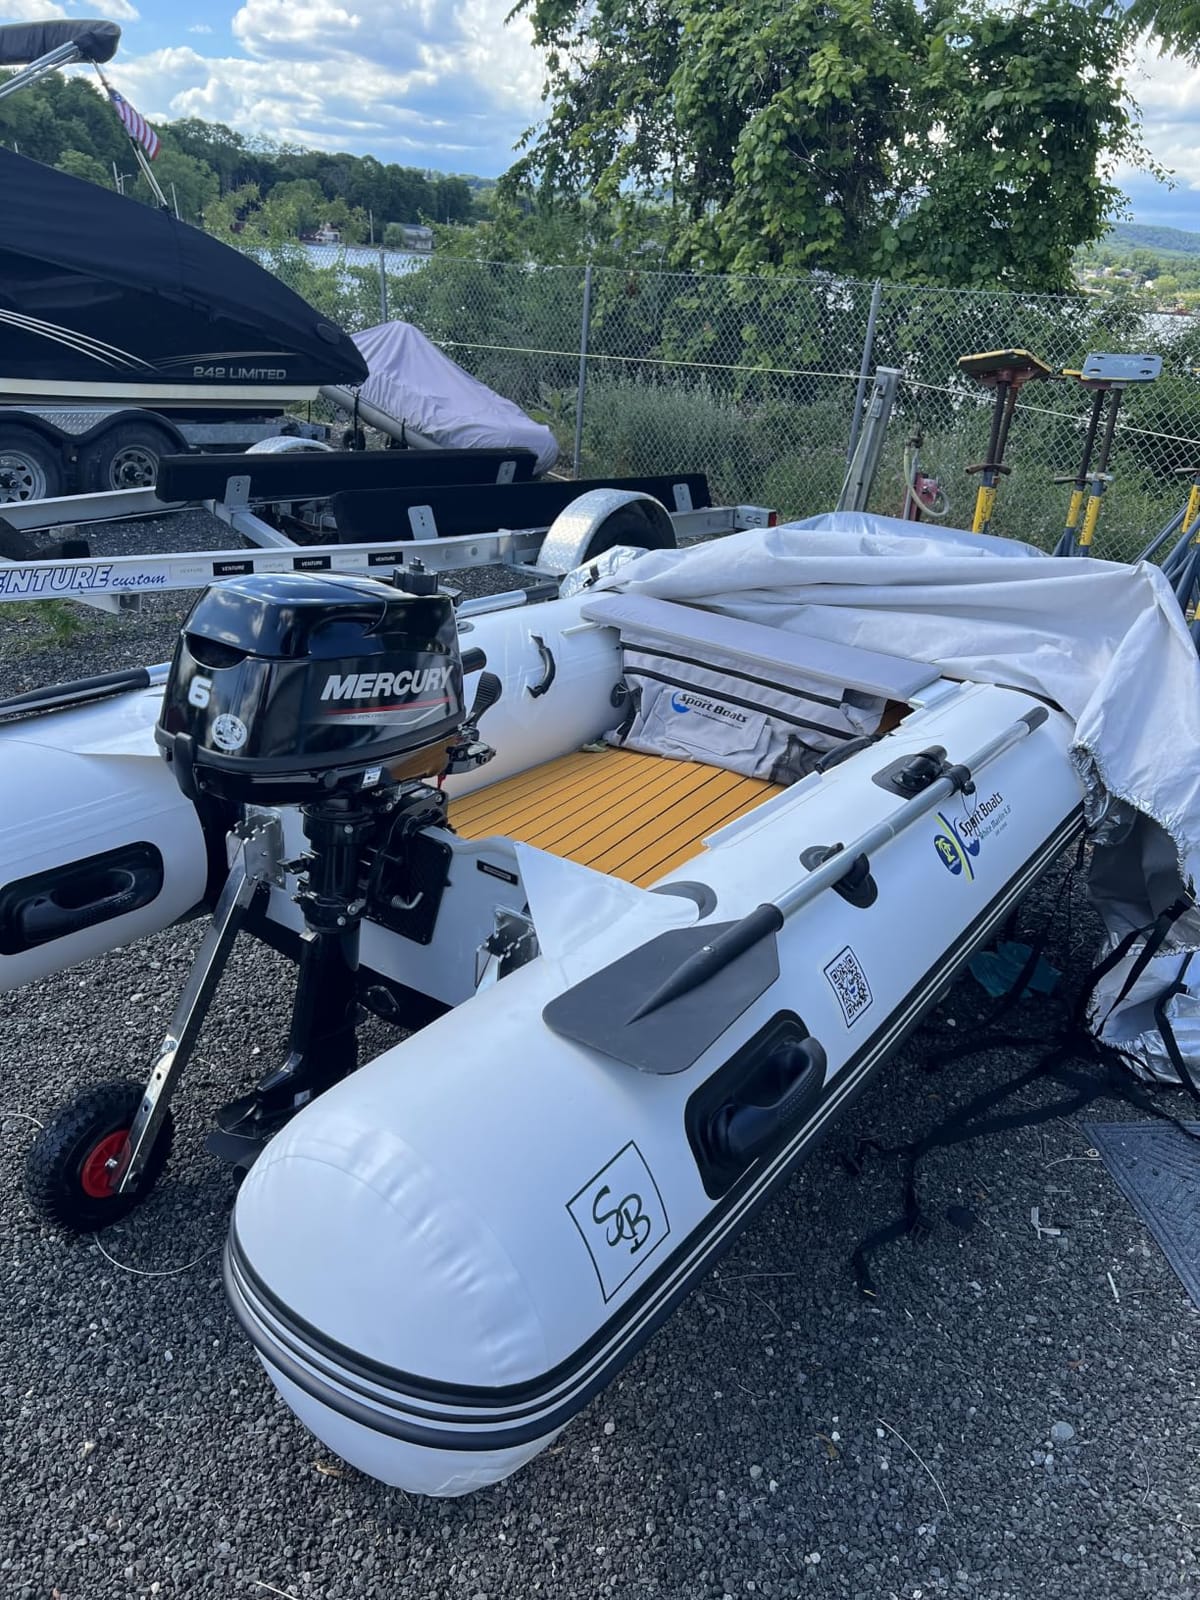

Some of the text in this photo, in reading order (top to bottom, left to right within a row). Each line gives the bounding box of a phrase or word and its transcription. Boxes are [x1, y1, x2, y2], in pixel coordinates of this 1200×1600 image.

[193, 366, 287, 380] 242 LIMITED
[112, 573, 166, 587] custom
[188, 675, 212, 709] 6
[320, 665, 454, 701] MERCURY
[679, 693, 714, 712] Sport
[713, 705, 748, 723] Boats
[959, 811, 984, 837] Sport
[978, 792, 1003, 817] Boats
